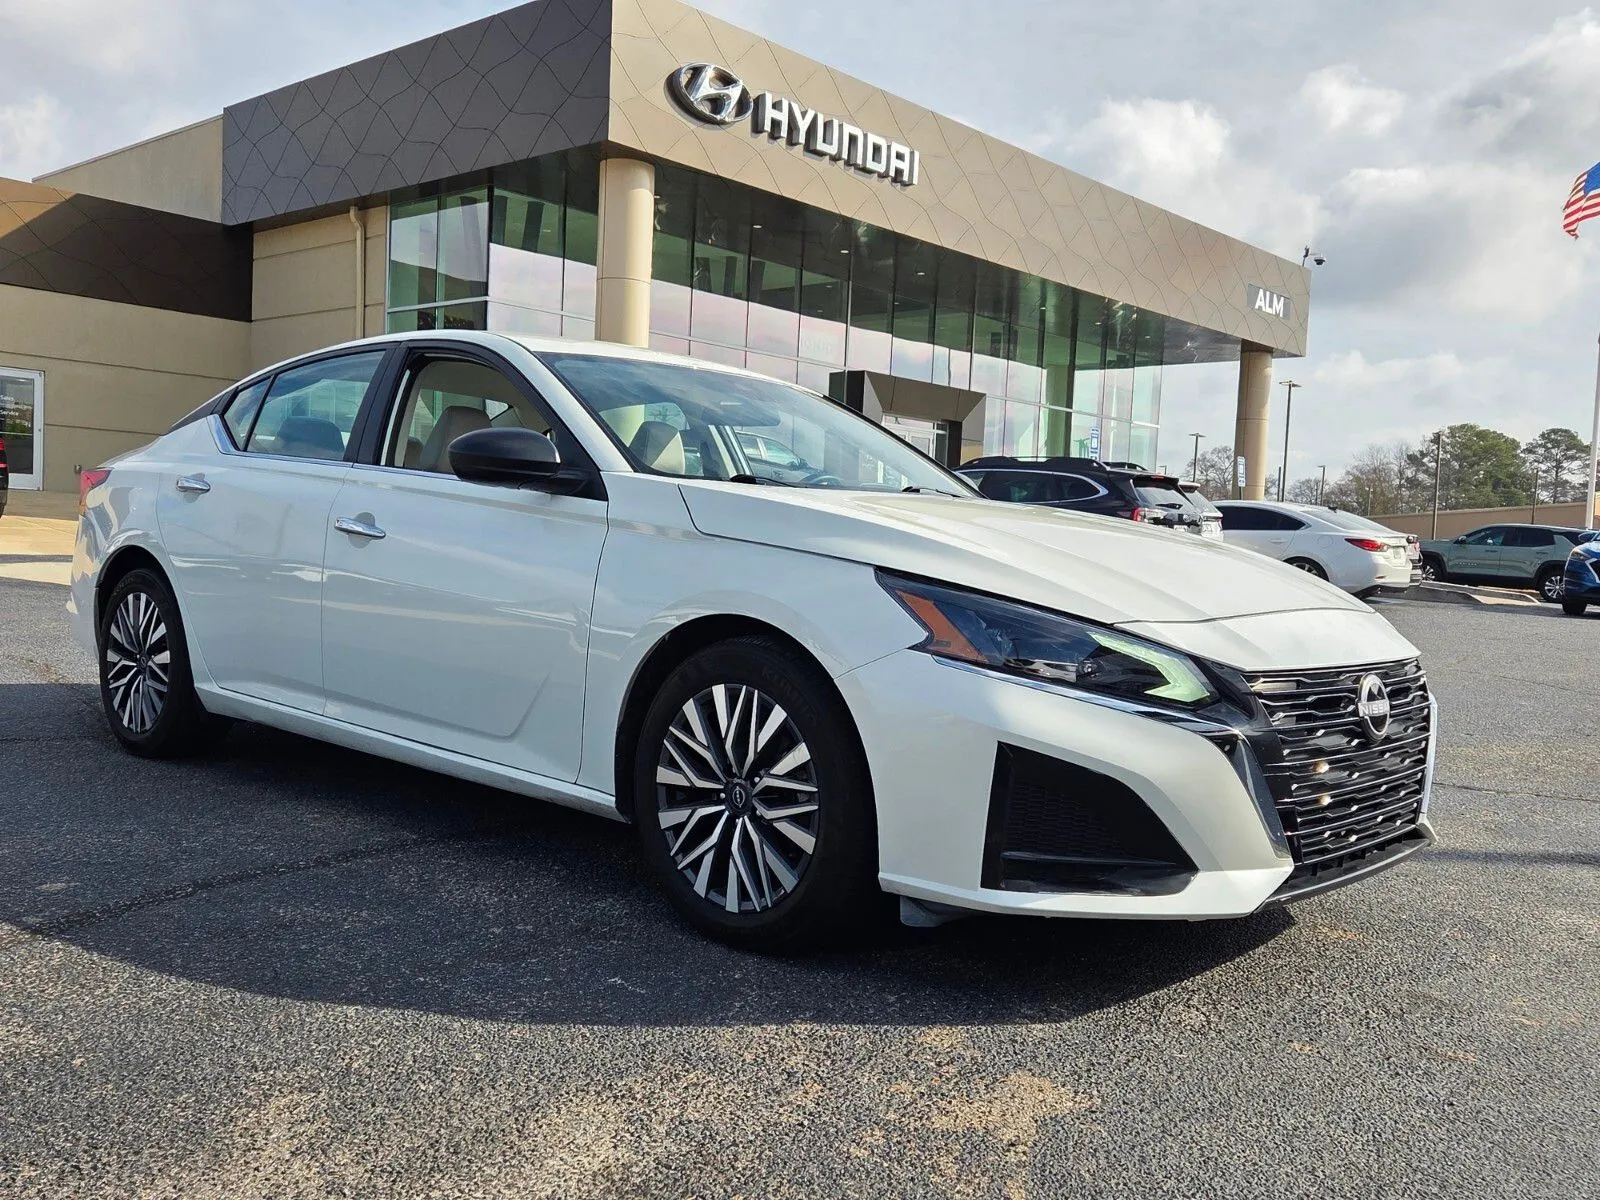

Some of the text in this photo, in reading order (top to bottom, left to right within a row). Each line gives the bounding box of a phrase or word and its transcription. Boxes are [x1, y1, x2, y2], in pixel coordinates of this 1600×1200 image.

[758, 92, 919, 186] HYUNDAI
[1254, 288, 1285, 318] ALM
[1358, 701, 1389, 717] NISS
